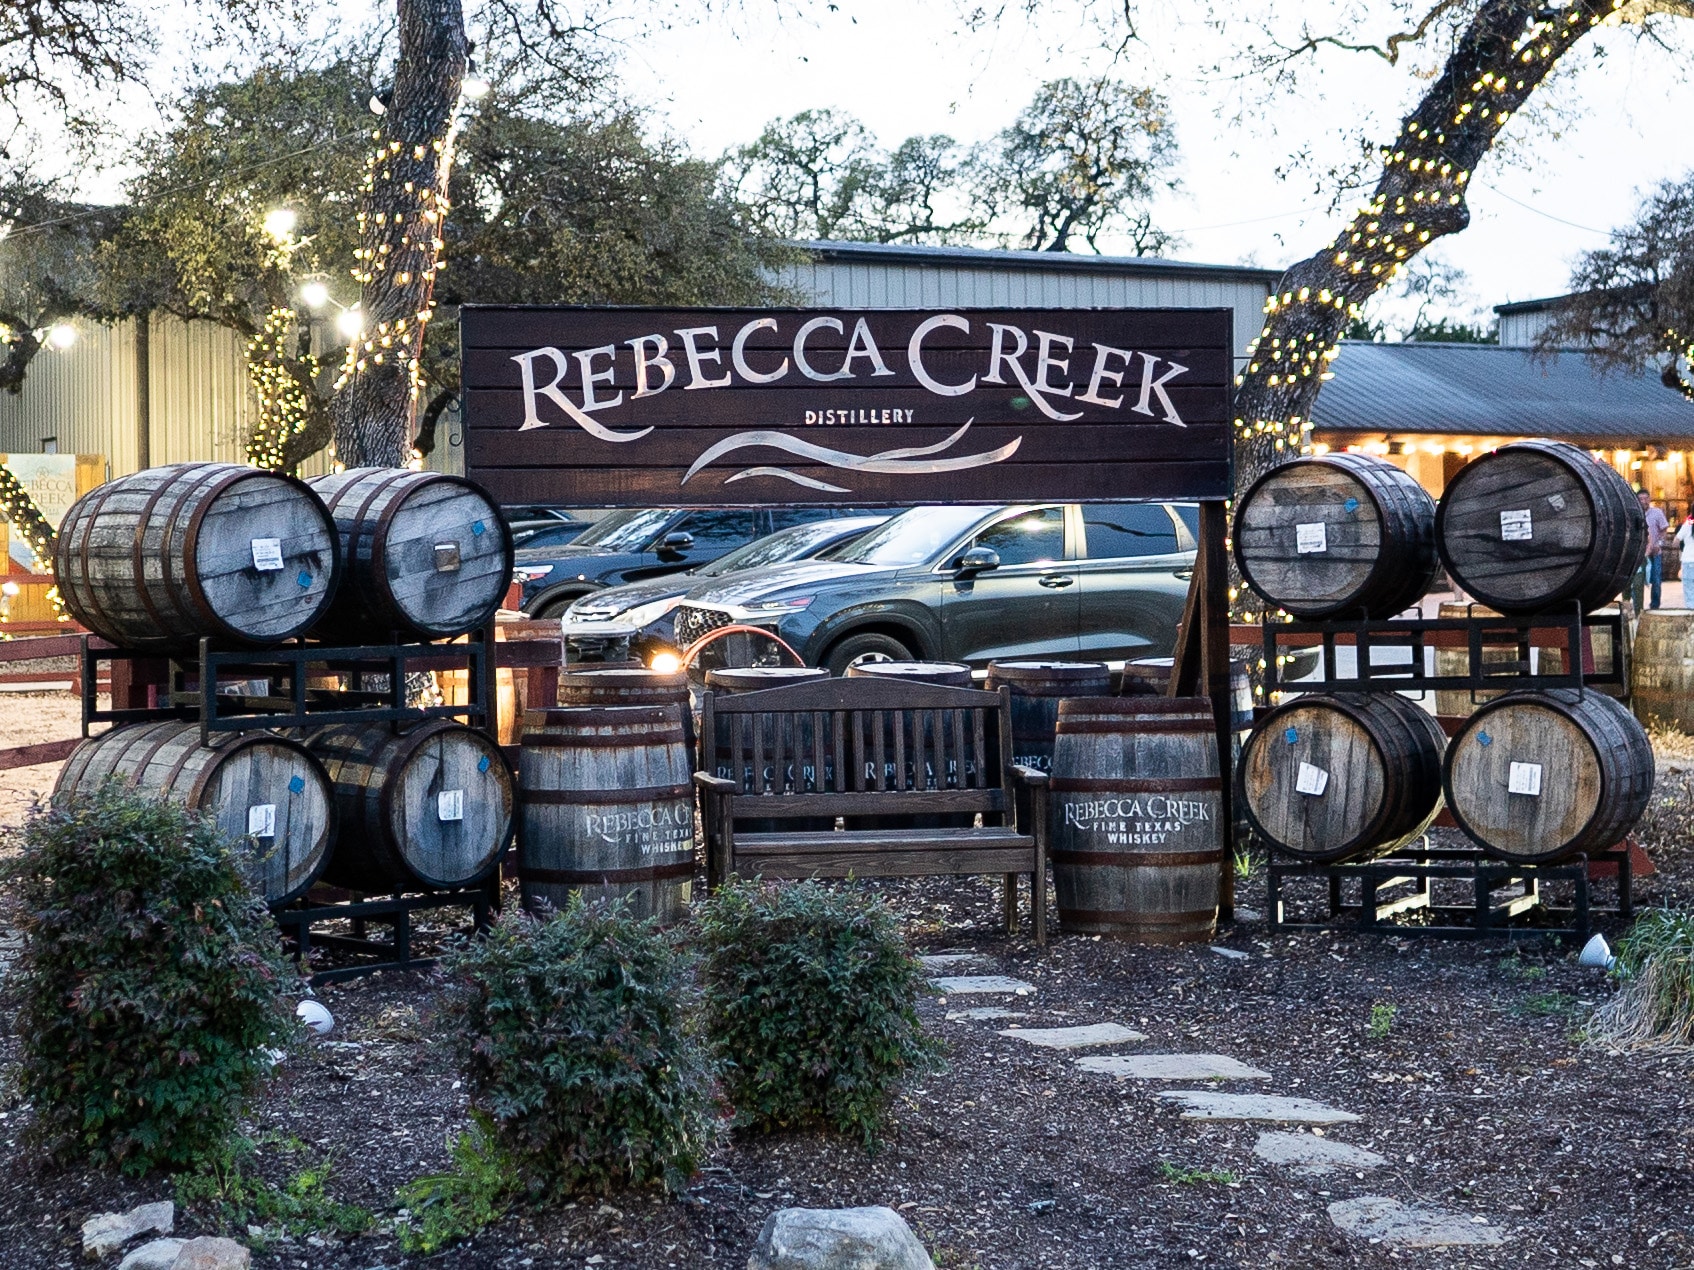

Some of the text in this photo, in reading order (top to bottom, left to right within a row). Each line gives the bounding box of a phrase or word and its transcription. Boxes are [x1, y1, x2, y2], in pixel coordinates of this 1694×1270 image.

[508, 313, 1190, 443] REBECCA CREEK
[805, 408, 914, 425] DISTILLERY
[1065, 796, 1210, 830] REBECCA CREEK
[585, 807, 672, 843] REBECCA
[1093, 821, 1182, 832] FINE TEXAS
[625, 831, 658, 843] FINE
[1107, 832, 1167, 844] WHISKEY
